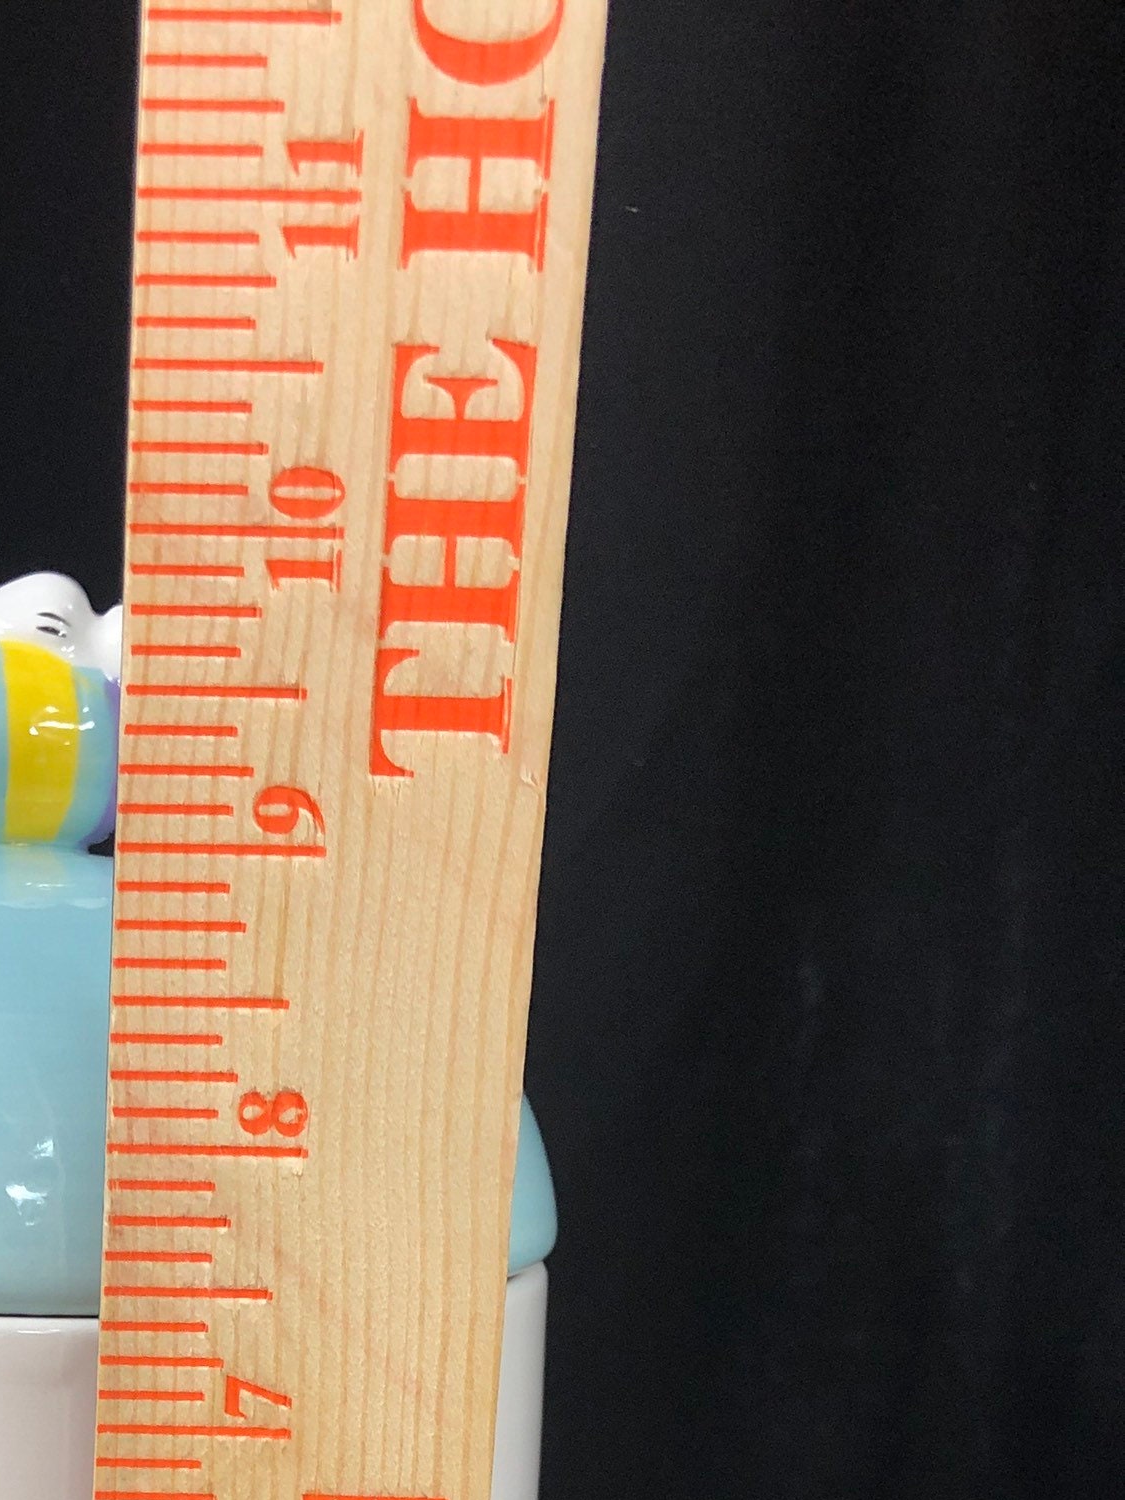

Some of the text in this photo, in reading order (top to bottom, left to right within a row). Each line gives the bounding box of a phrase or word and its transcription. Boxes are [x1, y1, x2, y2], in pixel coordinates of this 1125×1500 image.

[280, 130, 364, 258] 11
[264, 464, 348, 592] 10
[368, 336, 540, 779] THE
[252, 783, 327, 836] 9
[236, 1089, 311, 1139] 8
[223, 1374, 294, 1421] 7
